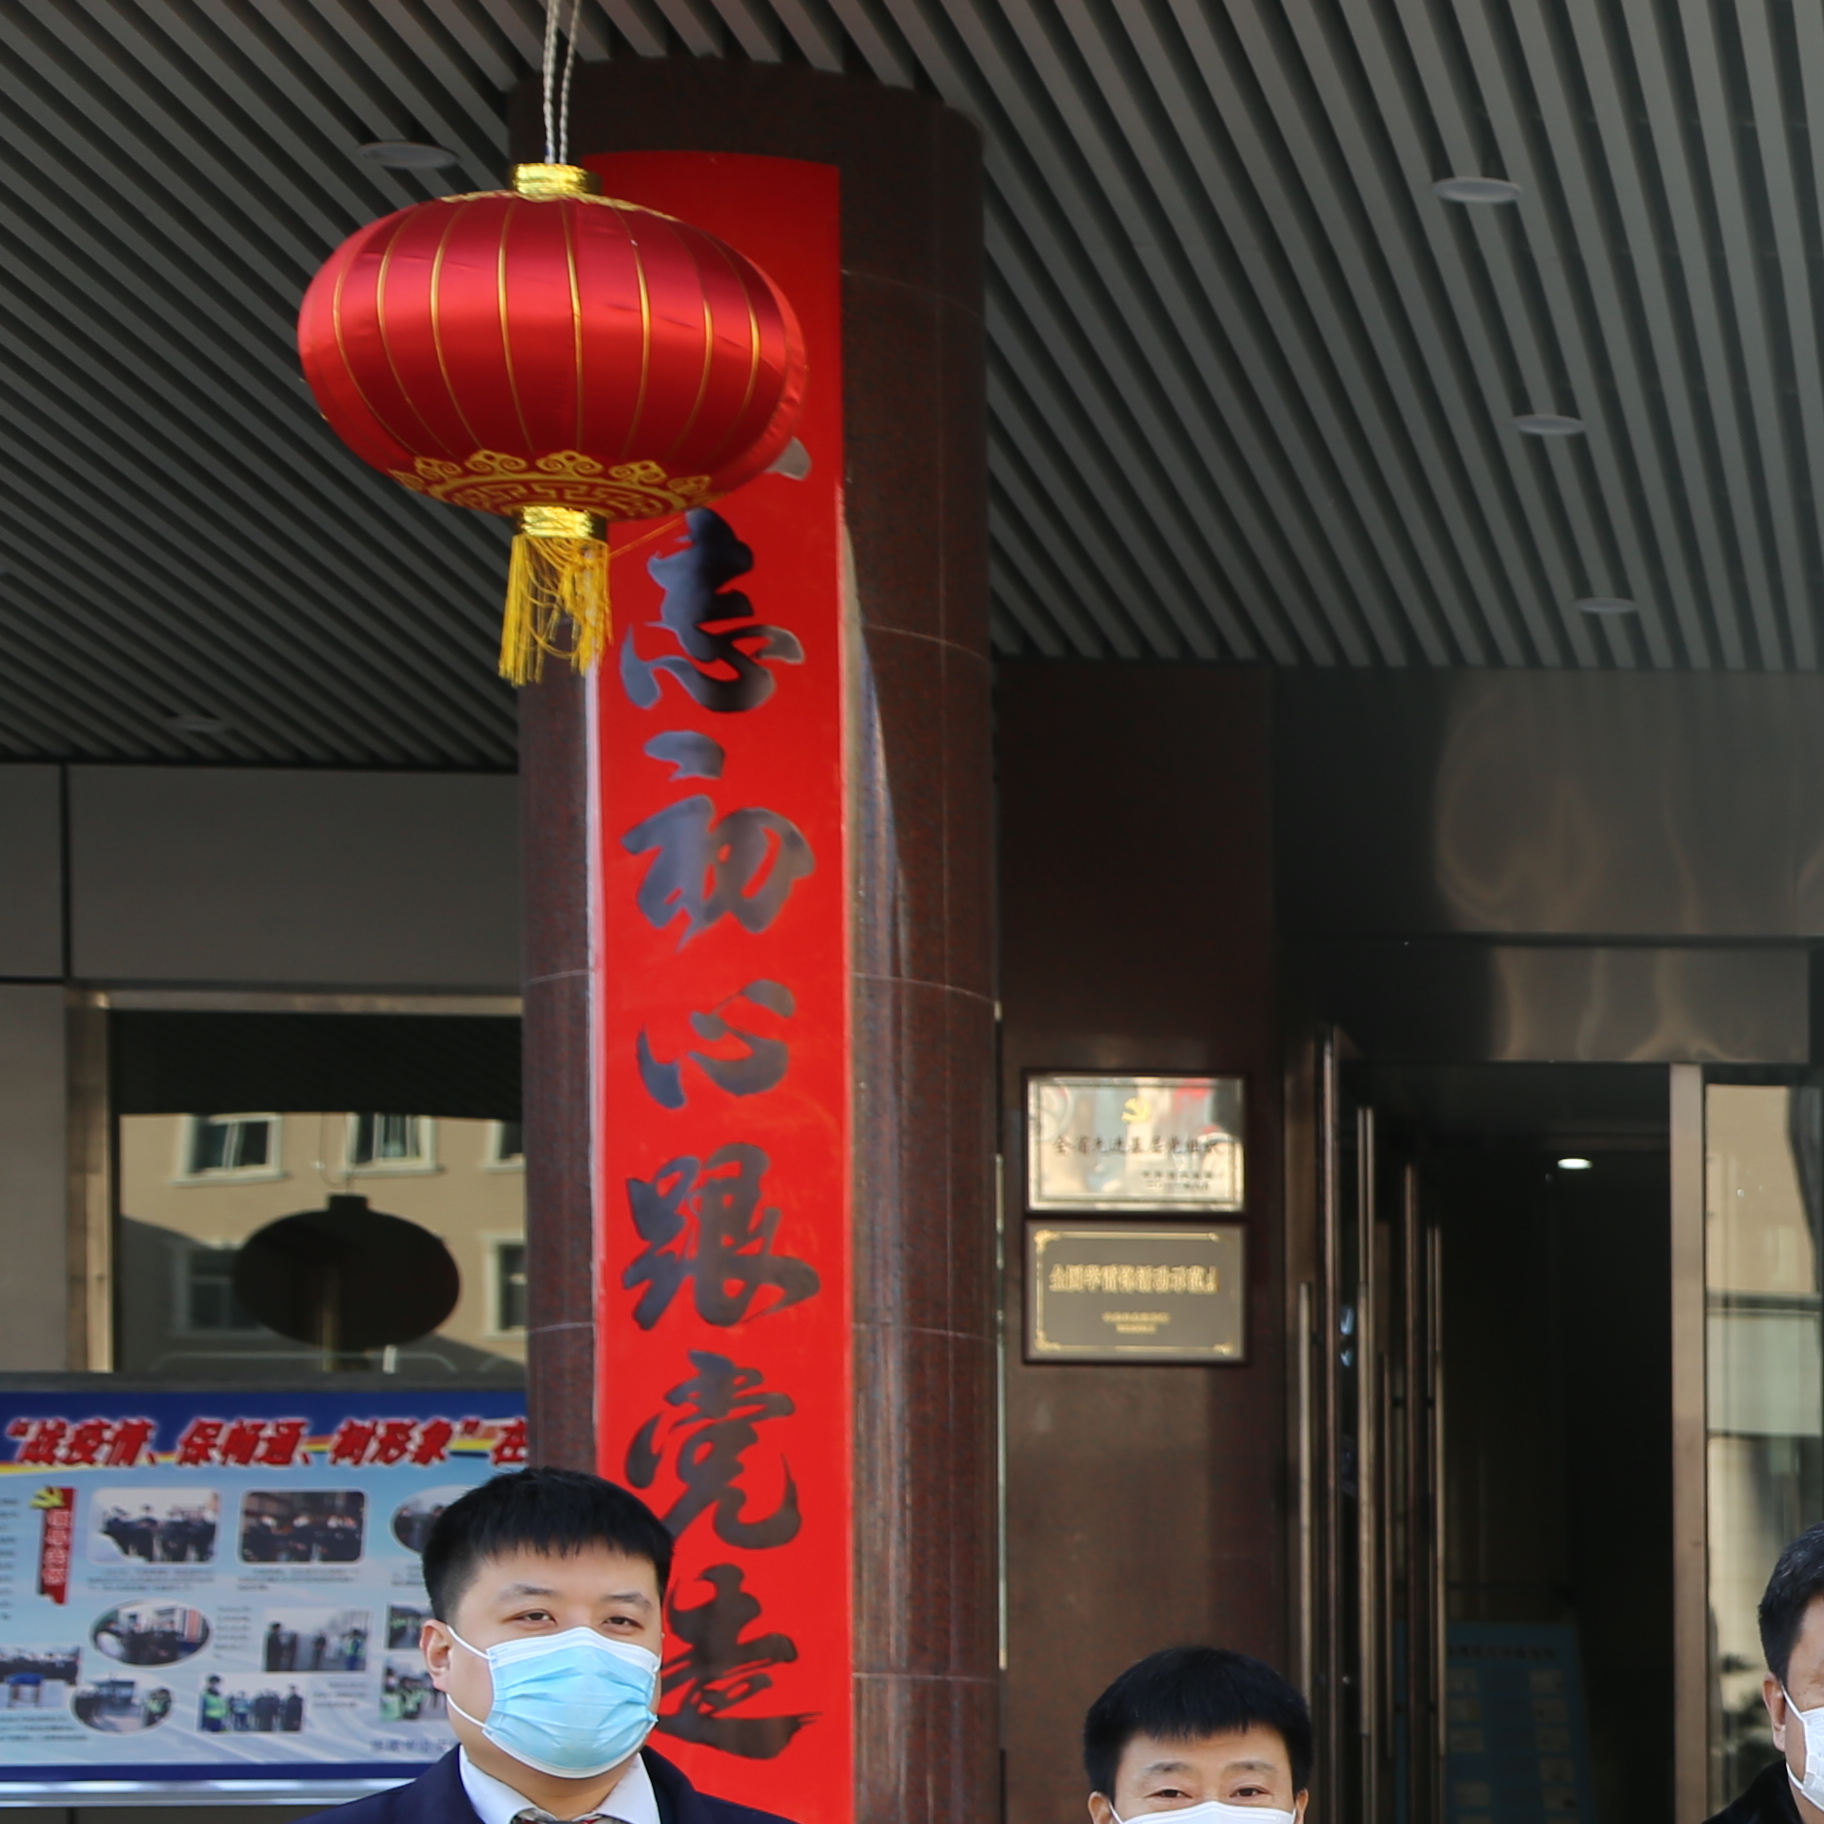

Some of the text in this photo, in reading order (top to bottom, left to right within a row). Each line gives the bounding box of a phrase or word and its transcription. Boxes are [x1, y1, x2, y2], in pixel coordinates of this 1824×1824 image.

[620, 437, 823, 1760] 忘初心跟党走
